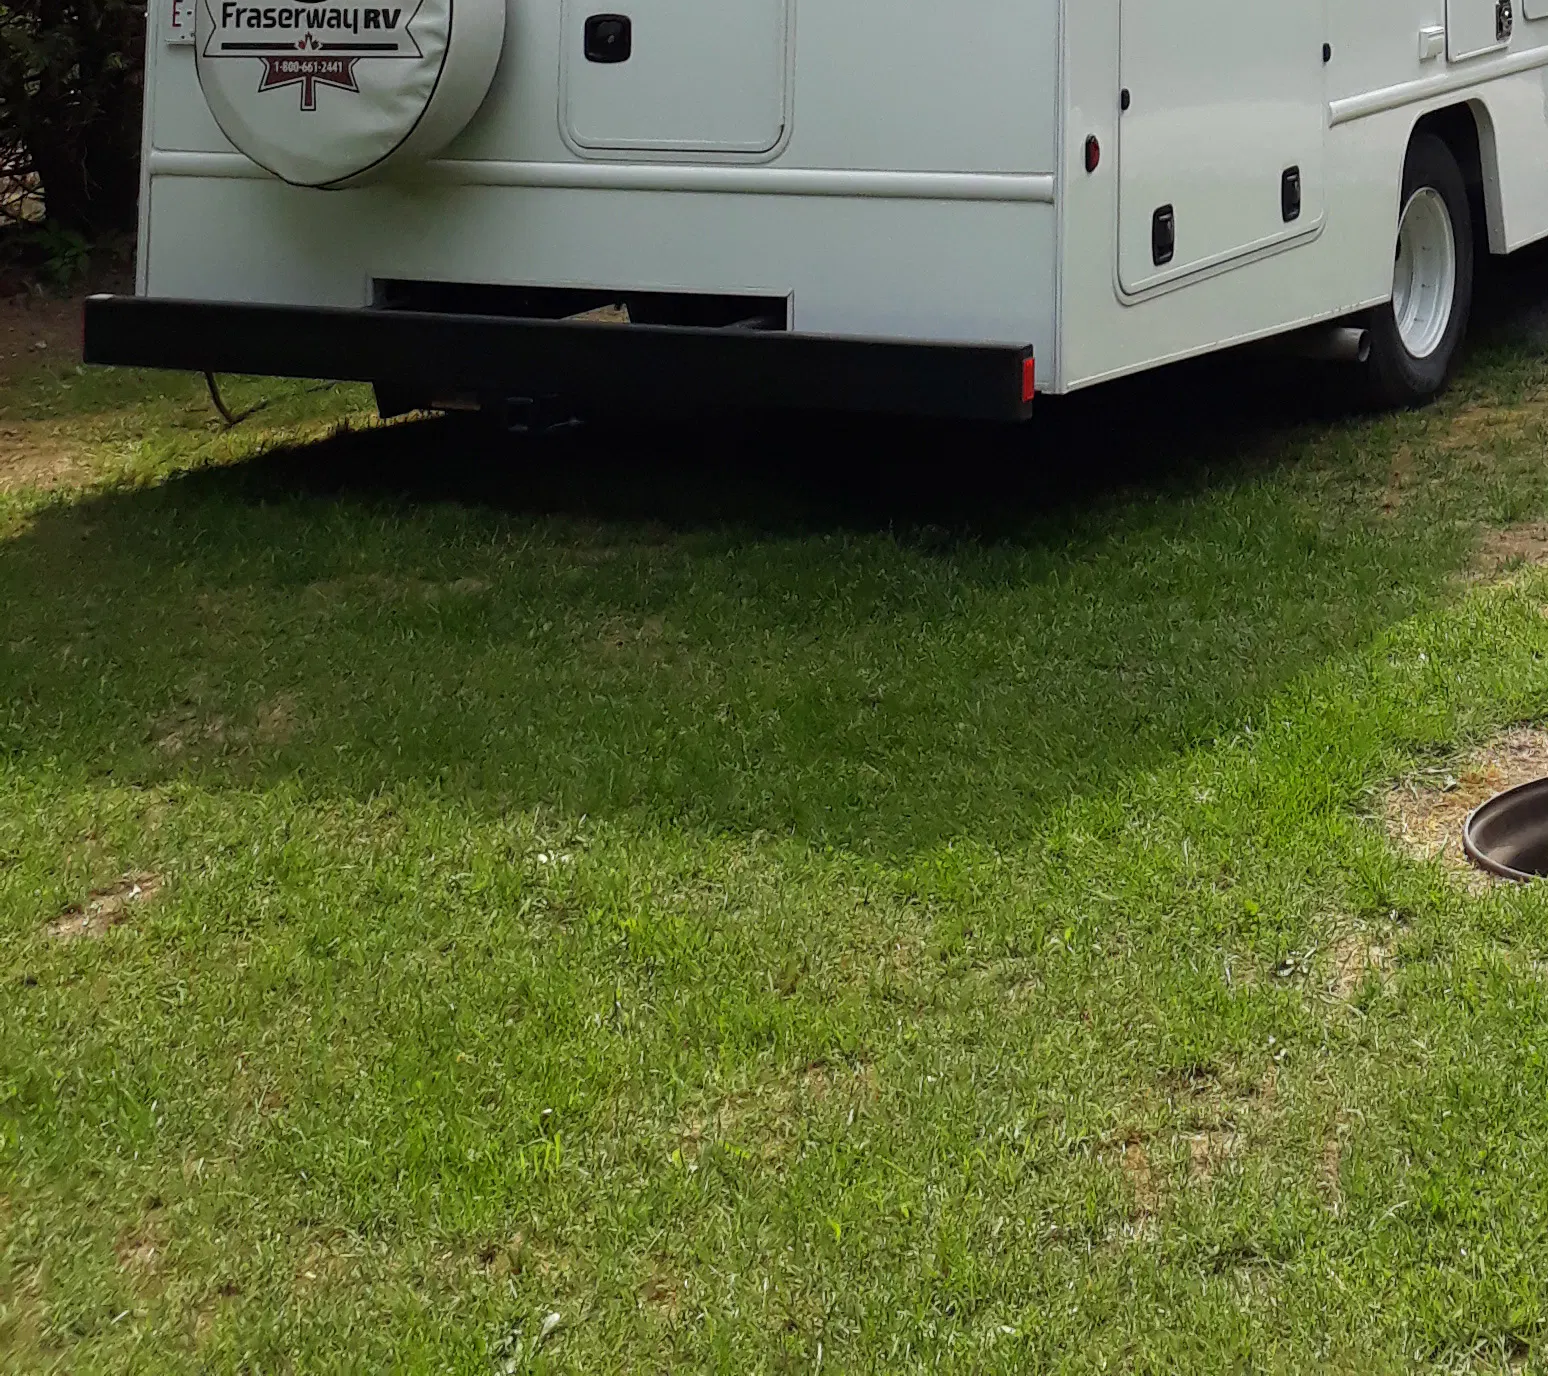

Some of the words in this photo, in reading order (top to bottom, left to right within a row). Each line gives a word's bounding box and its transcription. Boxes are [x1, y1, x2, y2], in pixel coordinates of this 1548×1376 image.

[221, 1, 358, 35] Fraserway
[363, 8, 402, 29] RV
[273, 60, 344, 74] 1-800-661-2441
